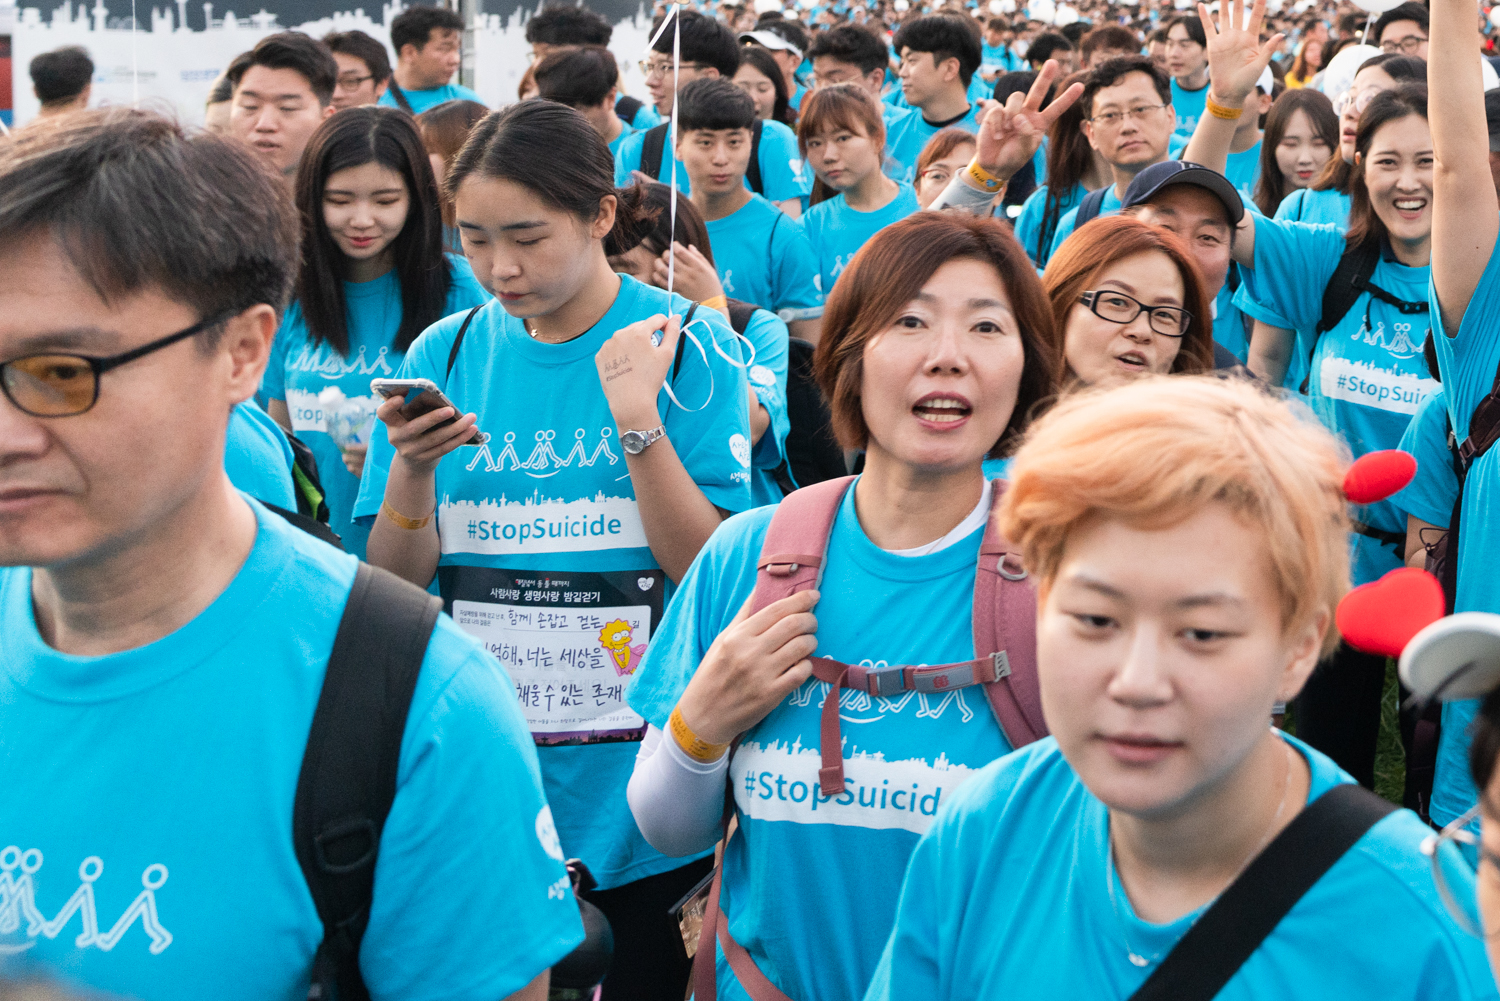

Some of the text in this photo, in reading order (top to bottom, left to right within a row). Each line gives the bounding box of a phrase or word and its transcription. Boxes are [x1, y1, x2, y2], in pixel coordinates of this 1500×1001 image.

[467, 513, 622, 545] #StopSuicide
[490, 587, 600, 603] 사람사랑 생명사랑 밤길걷기
[508, 608, 532, 626] 함께
[537, 611, 569, 629] 손잡고
[527, 646, 554, 668] 너는
[560, 646, 605, 669] 세상을
[560, 683, 584, 706] 있는
[592, 683, 626, 707] 존재
